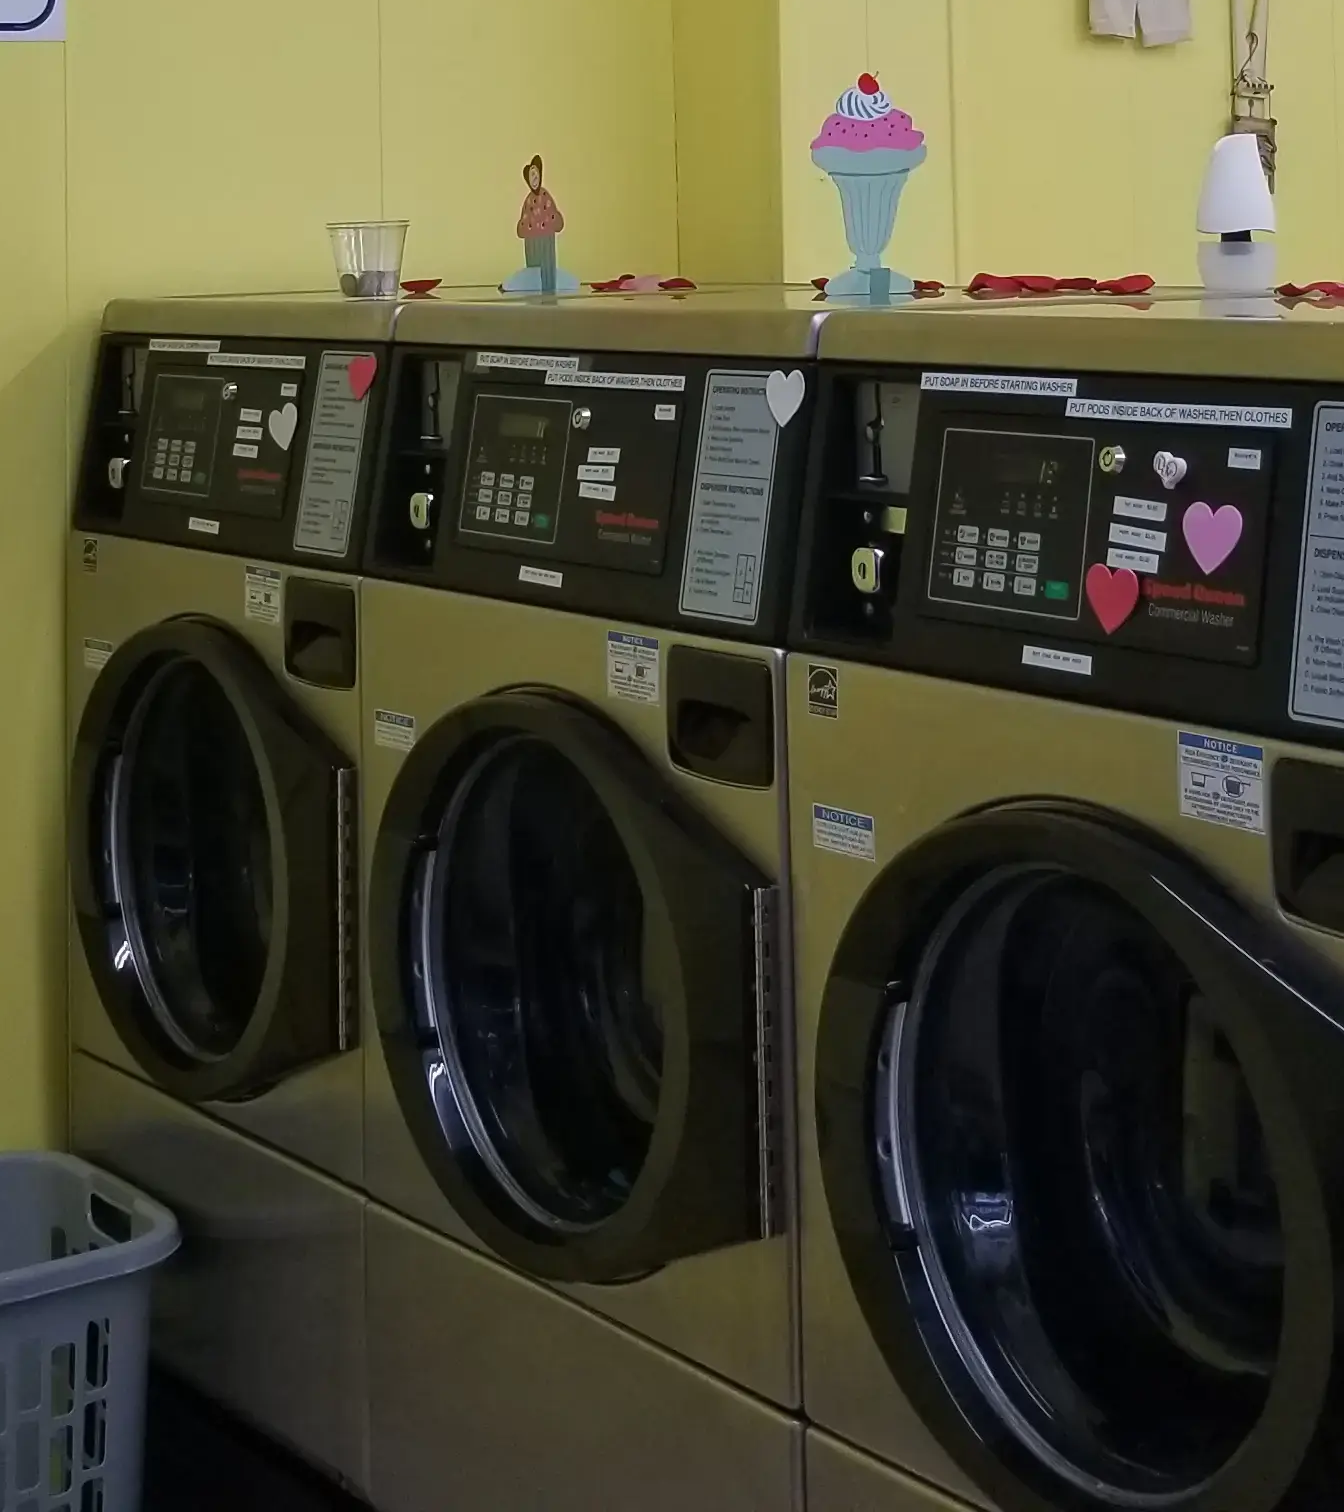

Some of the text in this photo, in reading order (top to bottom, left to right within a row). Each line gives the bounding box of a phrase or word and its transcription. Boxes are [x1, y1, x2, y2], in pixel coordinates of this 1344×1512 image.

[925, 376, 1072, 392] PUT SOAP IN BEFORE STARTING WASHER
[1070, 403, 1085, 413] PUT
[1087, 404, 1110, 414] PODS
[1112, 405, 1138, 417] INSIDE
[1140, 407, 1162, 418] BACK
[1164, 408, 1176, 418] OF
[1244, 411, 1288, 423] CLOTHES
[1148, 602, 1234, 627] Commercial Washer
[1204, 738, 1238, 753] NOTICE
[821, 809, 865, 828] NOTICE
